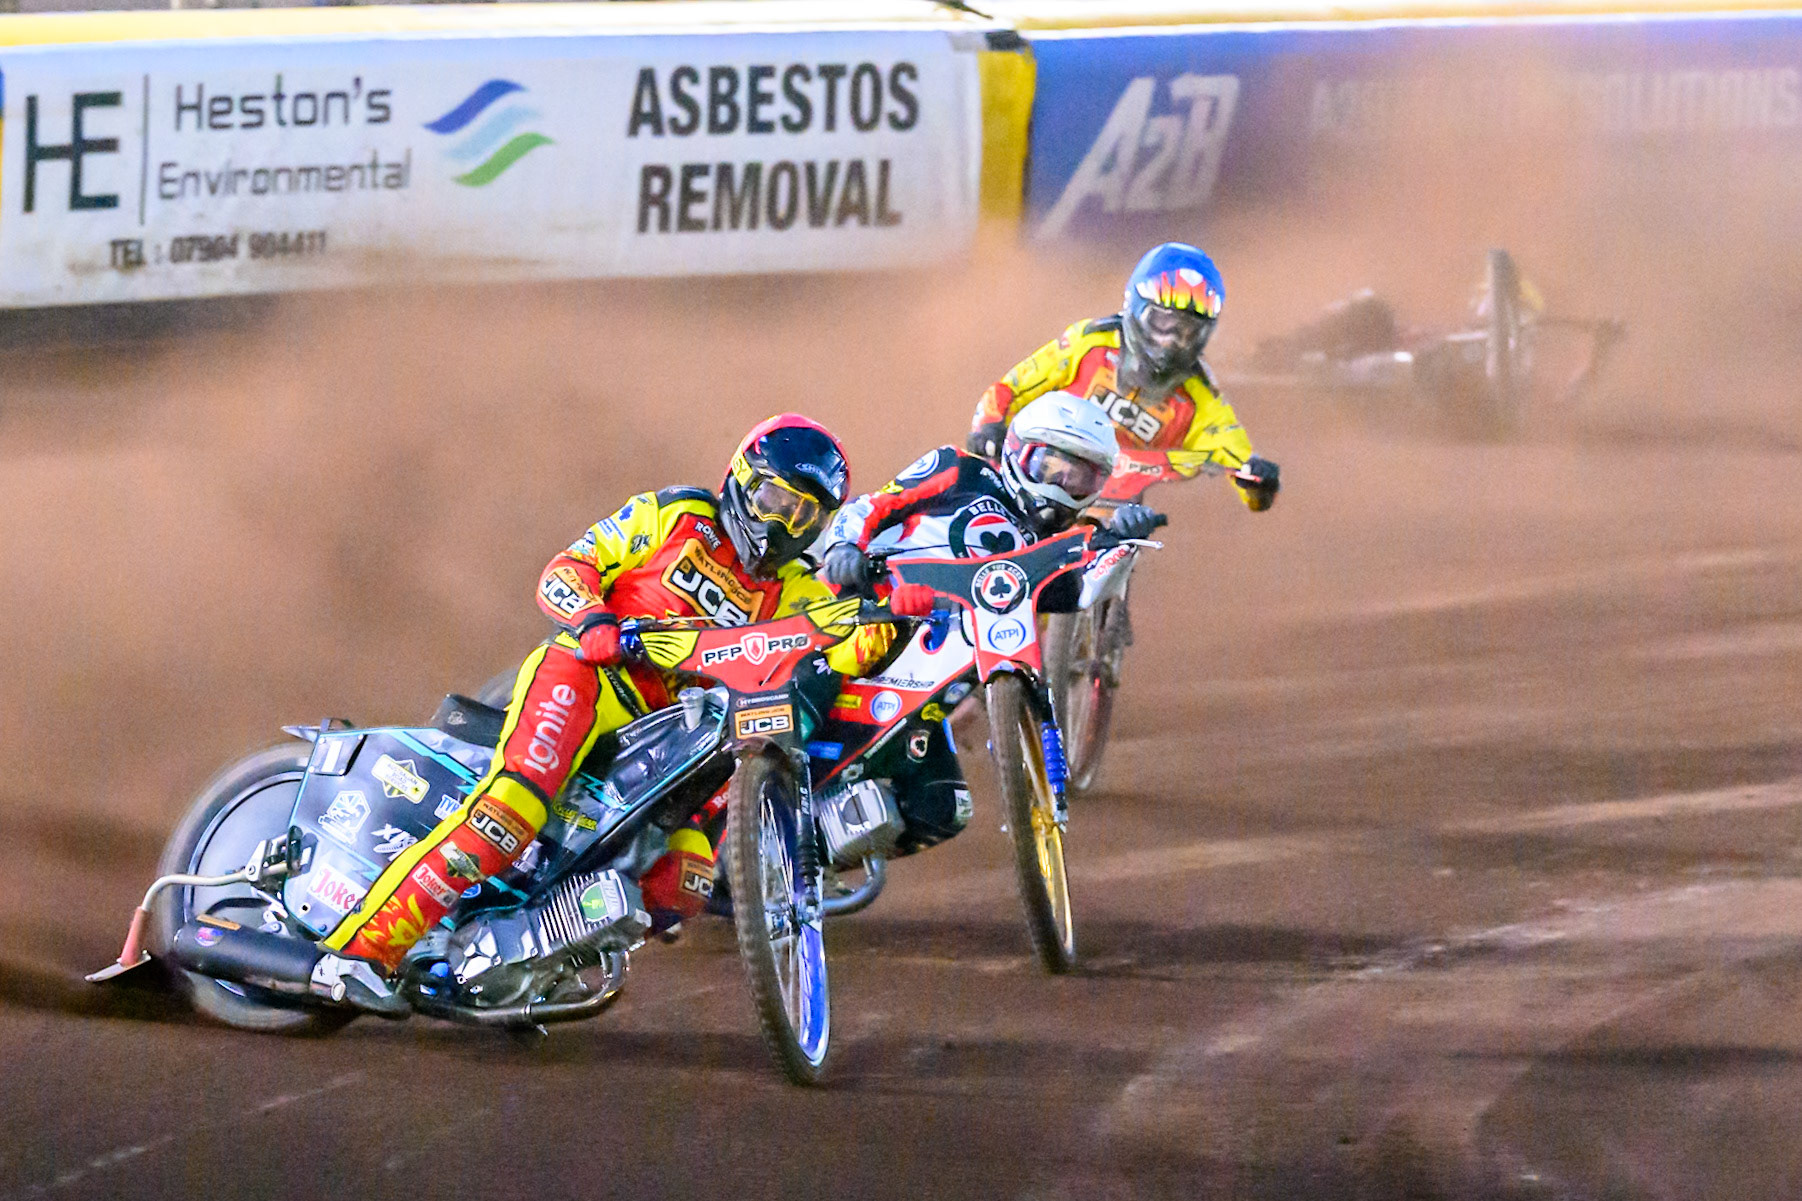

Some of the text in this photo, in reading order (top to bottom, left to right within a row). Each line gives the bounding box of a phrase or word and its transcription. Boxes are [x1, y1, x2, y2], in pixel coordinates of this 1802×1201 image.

[174, 74, 392, 132] Heston's
[627, 61, 919, 137] ASBESTOS
[157, 147, 412, 200] Environmental
[636, 159, 902, 233] REMOVAL
[1089, 391, 1161, 442] JCB
[541, 575, 588, 615] JCB
[671, 569, 748, 629] JCB
[704, 646, 742, 663] PFP
[768, 636, 808, 651] PRO
[994, 628, 1019, 641] ATPI
[523, 684, 577, 775] Ignite
[740, 715, 790, 735] JCB
[471, 813, 520, 854] JCB
[415, 866, 446, 896] Joker
